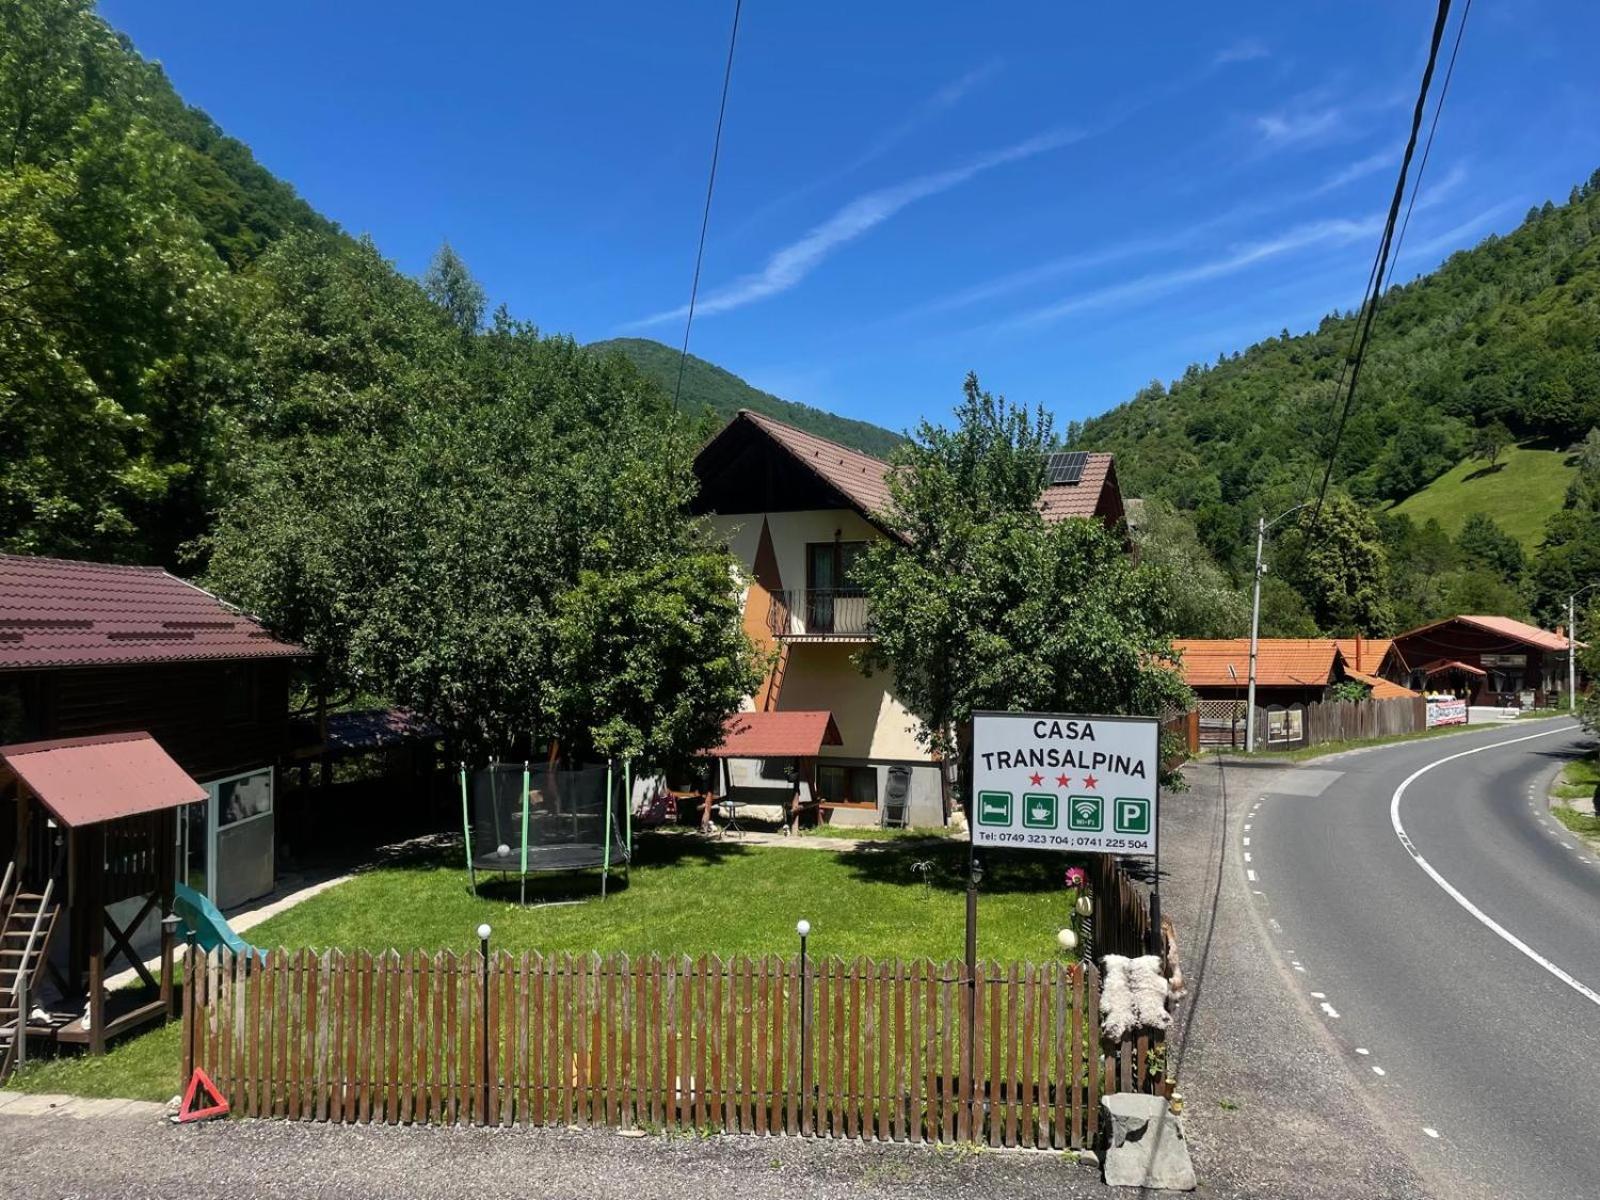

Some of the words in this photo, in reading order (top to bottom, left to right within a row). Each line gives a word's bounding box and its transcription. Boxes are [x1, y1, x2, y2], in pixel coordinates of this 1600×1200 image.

[1033, 720, 1096, 741] CASA
[981, 748, 1146, 779] TRANSALPINA
[1122, 804, 1141, 828] P
[979, 832, 997, 841] Tel:
[998, 832, 1025, 843] 0749
[1027, 834, 1047, 843] 323
[1050, 836, 1069, 845] 704
[1076, 837, 1102, 847] 0741
[1105, 838, 1126, 848] 225
[1128, 840, 1148, 849] 504
